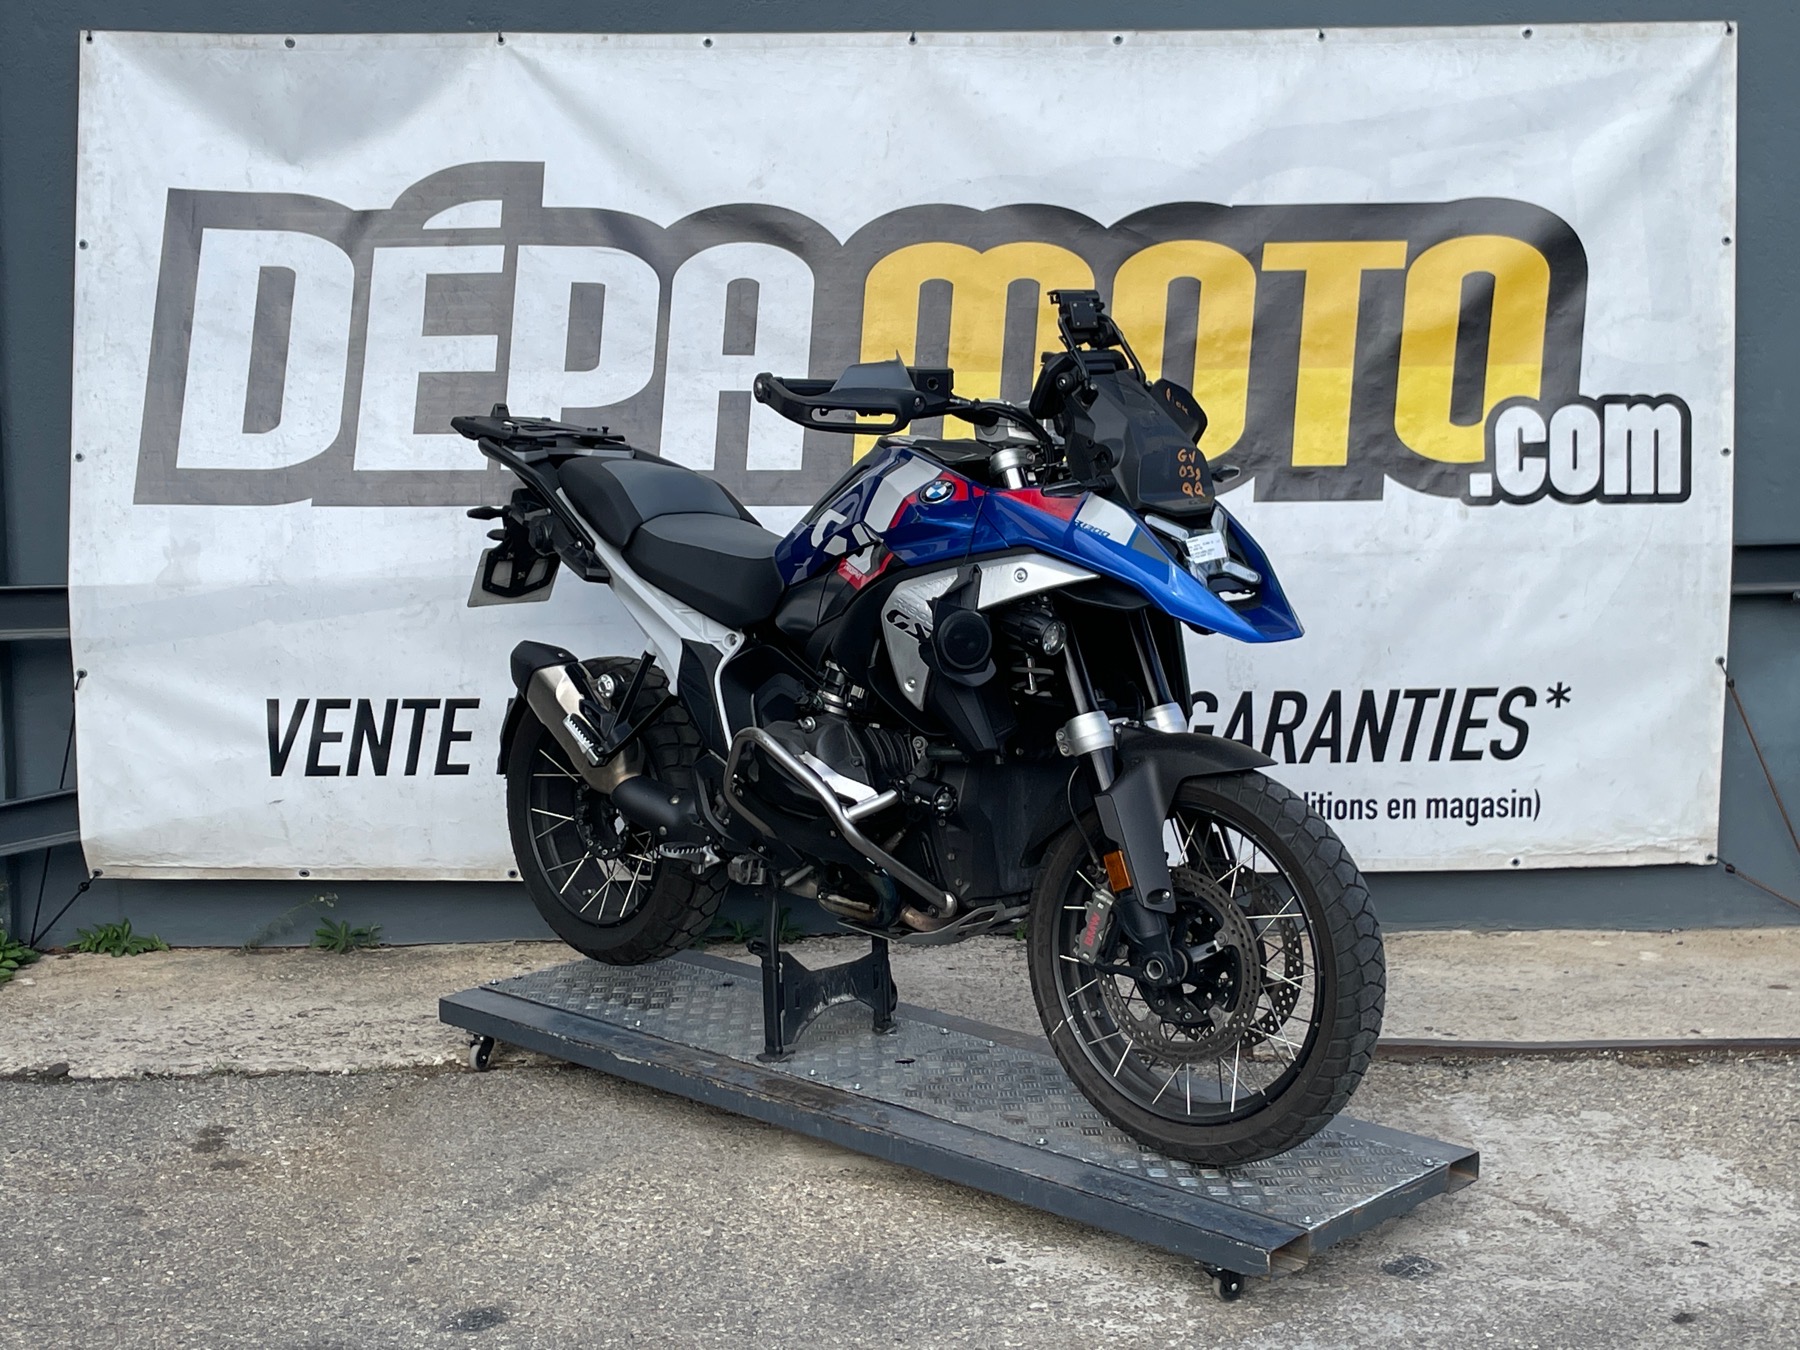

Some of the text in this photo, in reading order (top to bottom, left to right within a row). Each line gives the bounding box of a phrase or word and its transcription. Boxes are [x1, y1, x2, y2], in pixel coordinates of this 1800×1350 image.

[1177, 447, 1197, 464] GV
[265, 697, 481, 777] VENTE
[1387, 796, 1417, 820] en
[1425, 788, 1541, 827] magasin)
